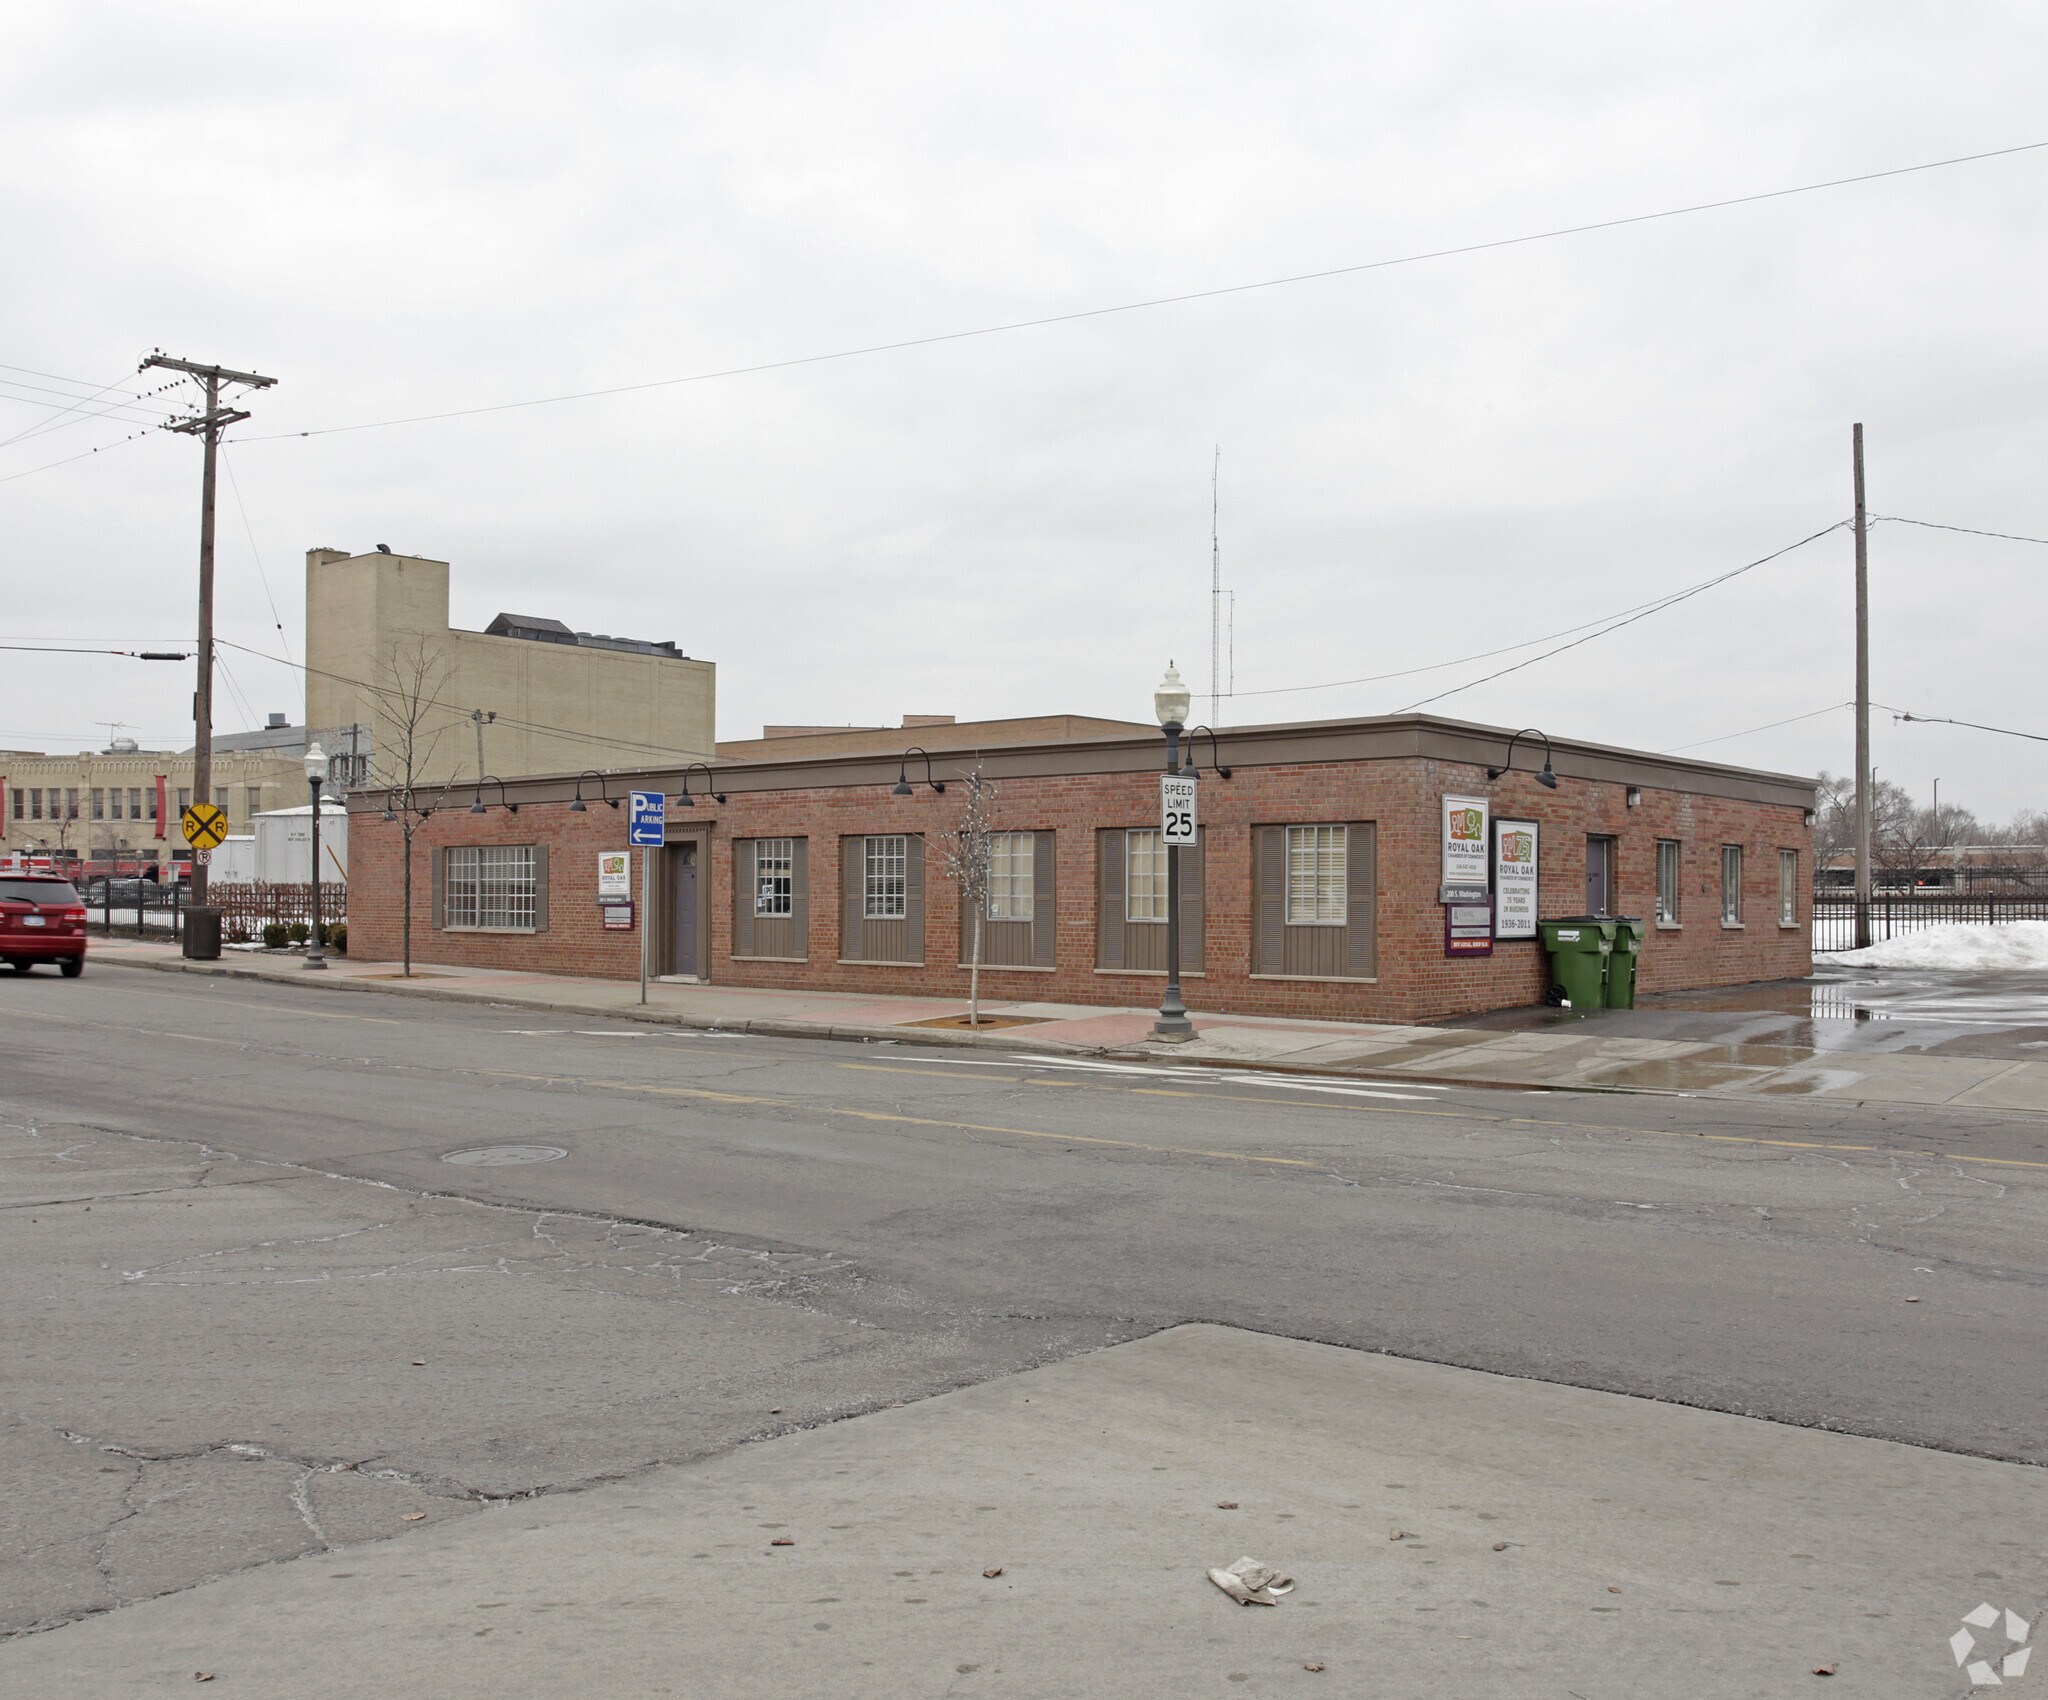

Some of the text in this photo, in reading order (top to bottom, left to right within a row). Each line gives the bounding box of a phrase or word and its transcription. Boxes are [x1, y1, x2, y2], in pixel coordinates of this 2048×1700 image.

[1164, 784, 1194, 796] SPEED
[1167, 798, 1190, 809] LIMIT
[1165, 812, 1193, 837] 25
[1448, 842, 1485, 853] ROYAL OAK
[1499, 864, 1534, 875] ROYAL OAK
[1458, 890, 1482, 899] Washington
[1503, 887, 1530, 895] CELEBRATING
[1501, 919, 1531, 929] 1936-2011
